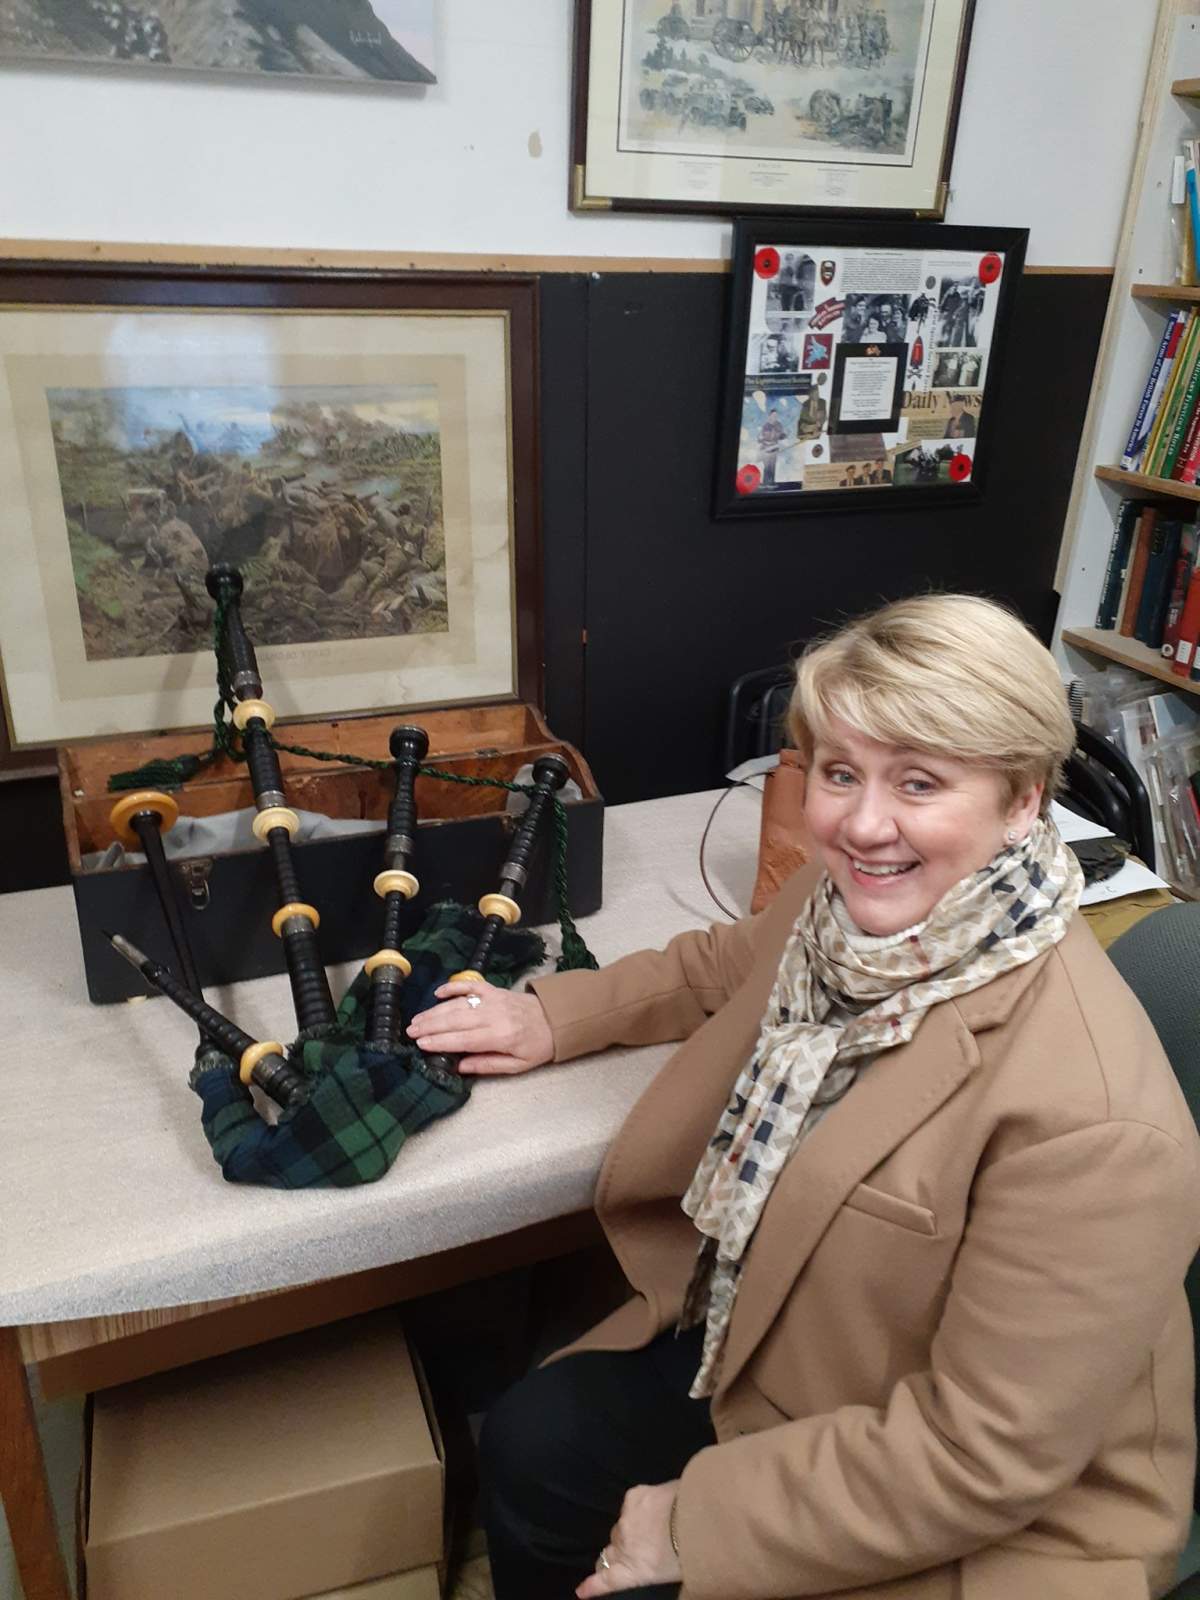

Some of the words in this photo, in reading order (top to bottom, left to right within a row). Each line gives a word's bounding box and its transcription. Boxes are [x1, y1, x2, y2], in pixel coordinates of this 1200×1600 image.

[1158, 340, 1168, 357] Arms
[1144, 377, 1156, 399] British
[902, 390, 940, 413] Daily
[942, 390, 984, 409] Nws
[1137, 399, 1148, 419] Forces
[1126, 427, 1139, 452] America
